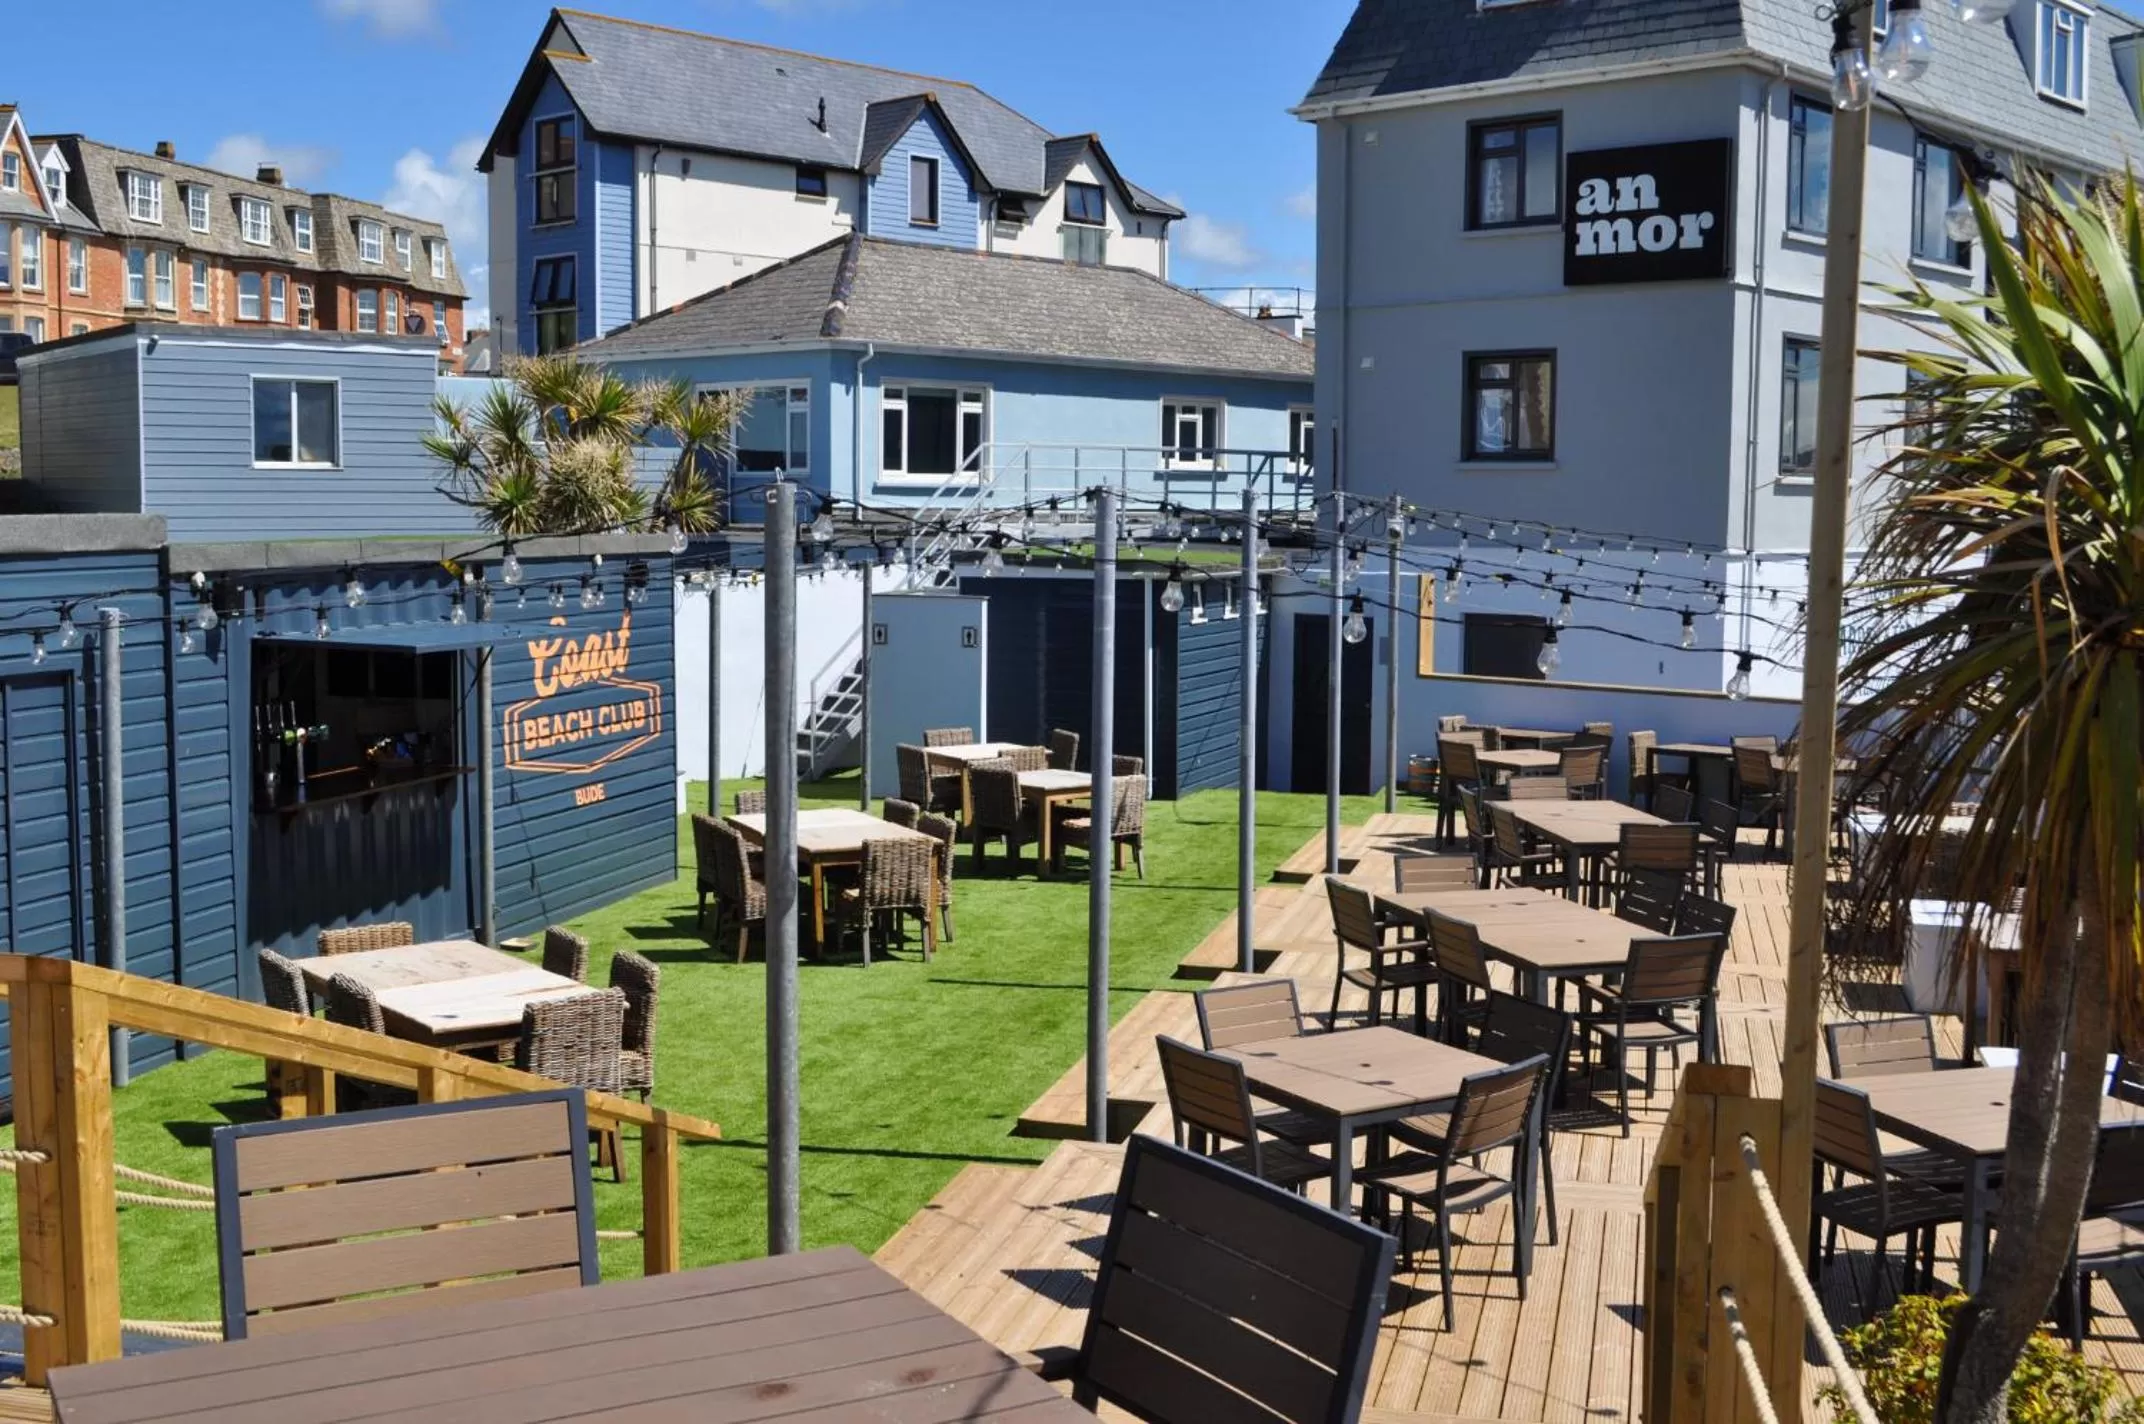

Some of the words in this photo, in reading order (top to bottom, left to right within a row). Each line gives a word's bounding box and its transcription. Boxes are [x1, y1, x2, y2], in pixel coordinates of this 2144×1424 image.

[1575, 173, 1660, 216] an
[1575, 210, 1715, 257] mor
[527, 608, 633, 697] Coast
[523, 709, 594, 751] BEACH
[598, 699, 646, 736] CLUB
[575, 784, 606, 806] BUDE
